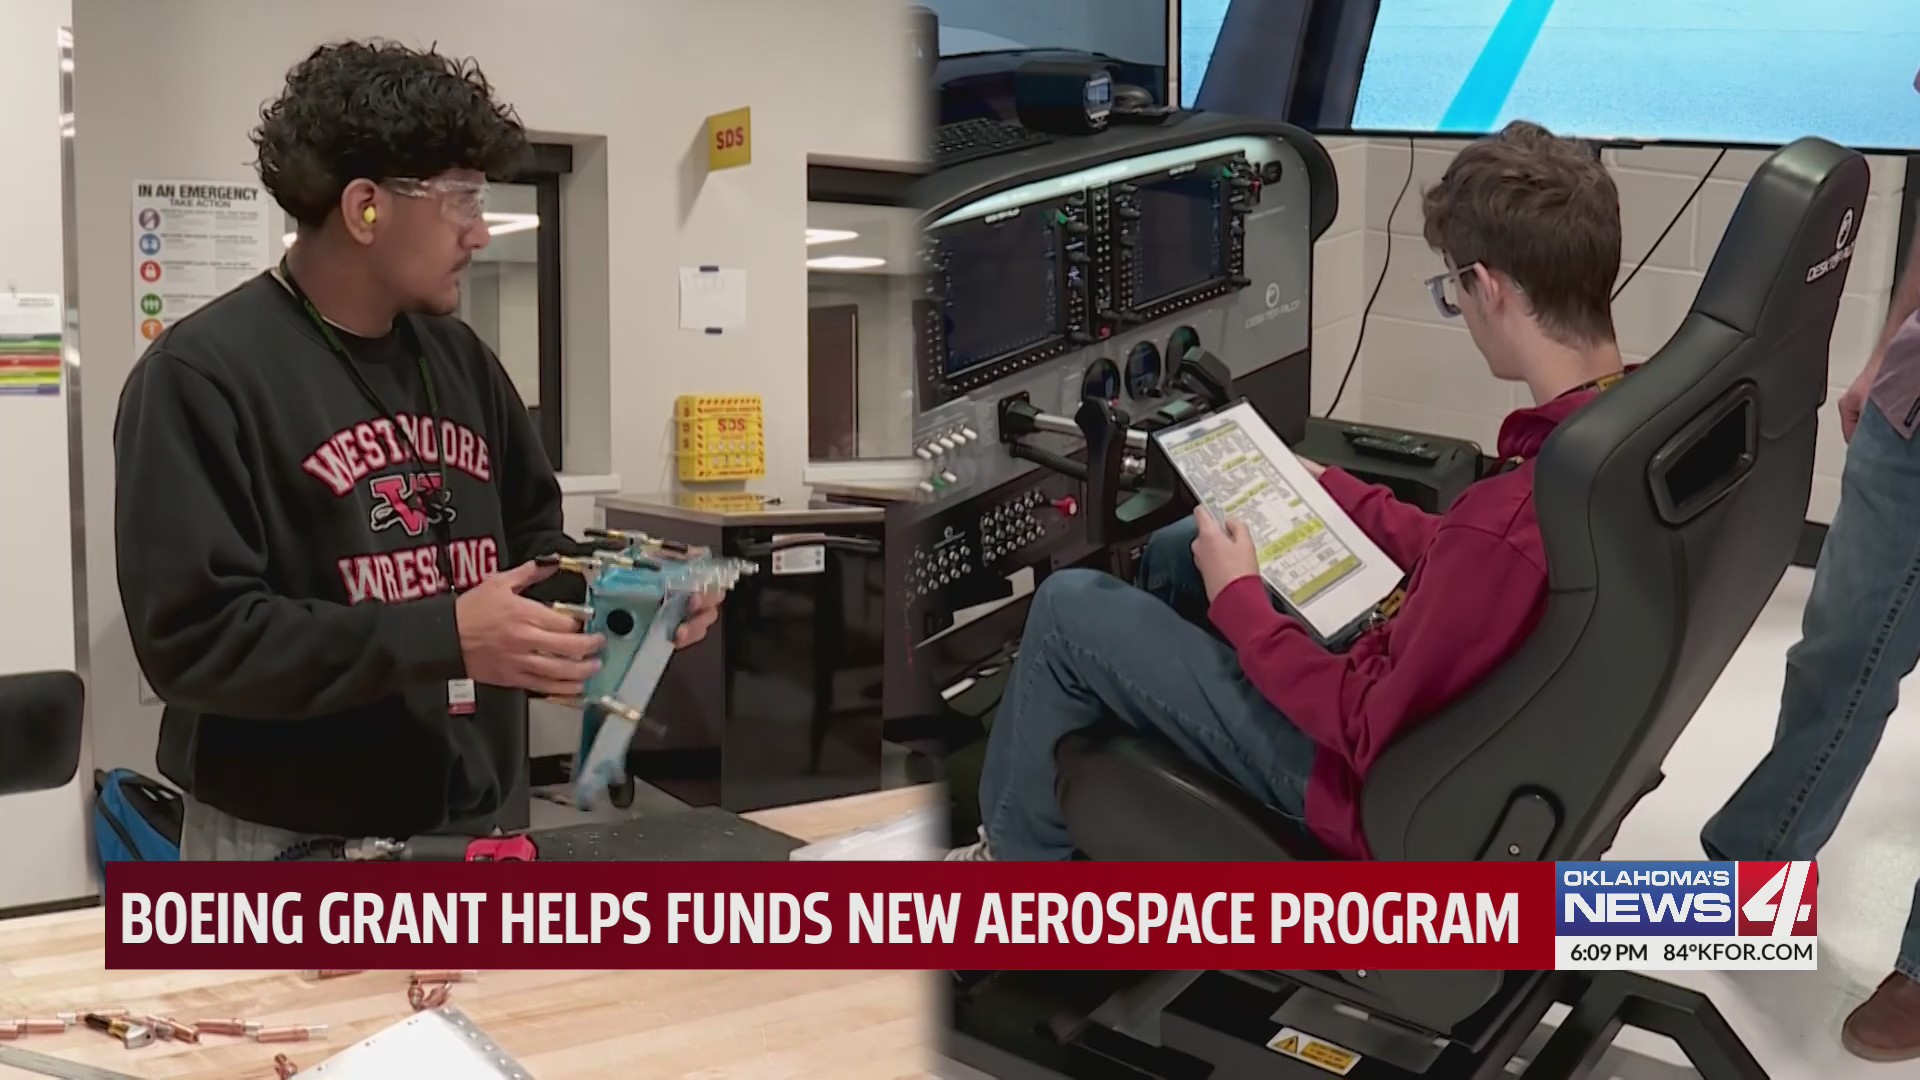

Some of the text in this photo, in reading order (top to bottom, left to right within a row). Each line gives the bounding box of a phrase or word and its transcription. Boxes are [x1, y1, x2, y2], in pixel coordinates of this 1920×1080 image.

[716, 126, 744, 150] SDS
[138, 183, 259, 201] IN AN EMERGENCY
[169, 199, 231, 209] TAKE ACTION
[717, 417, 746, 433] SDS
